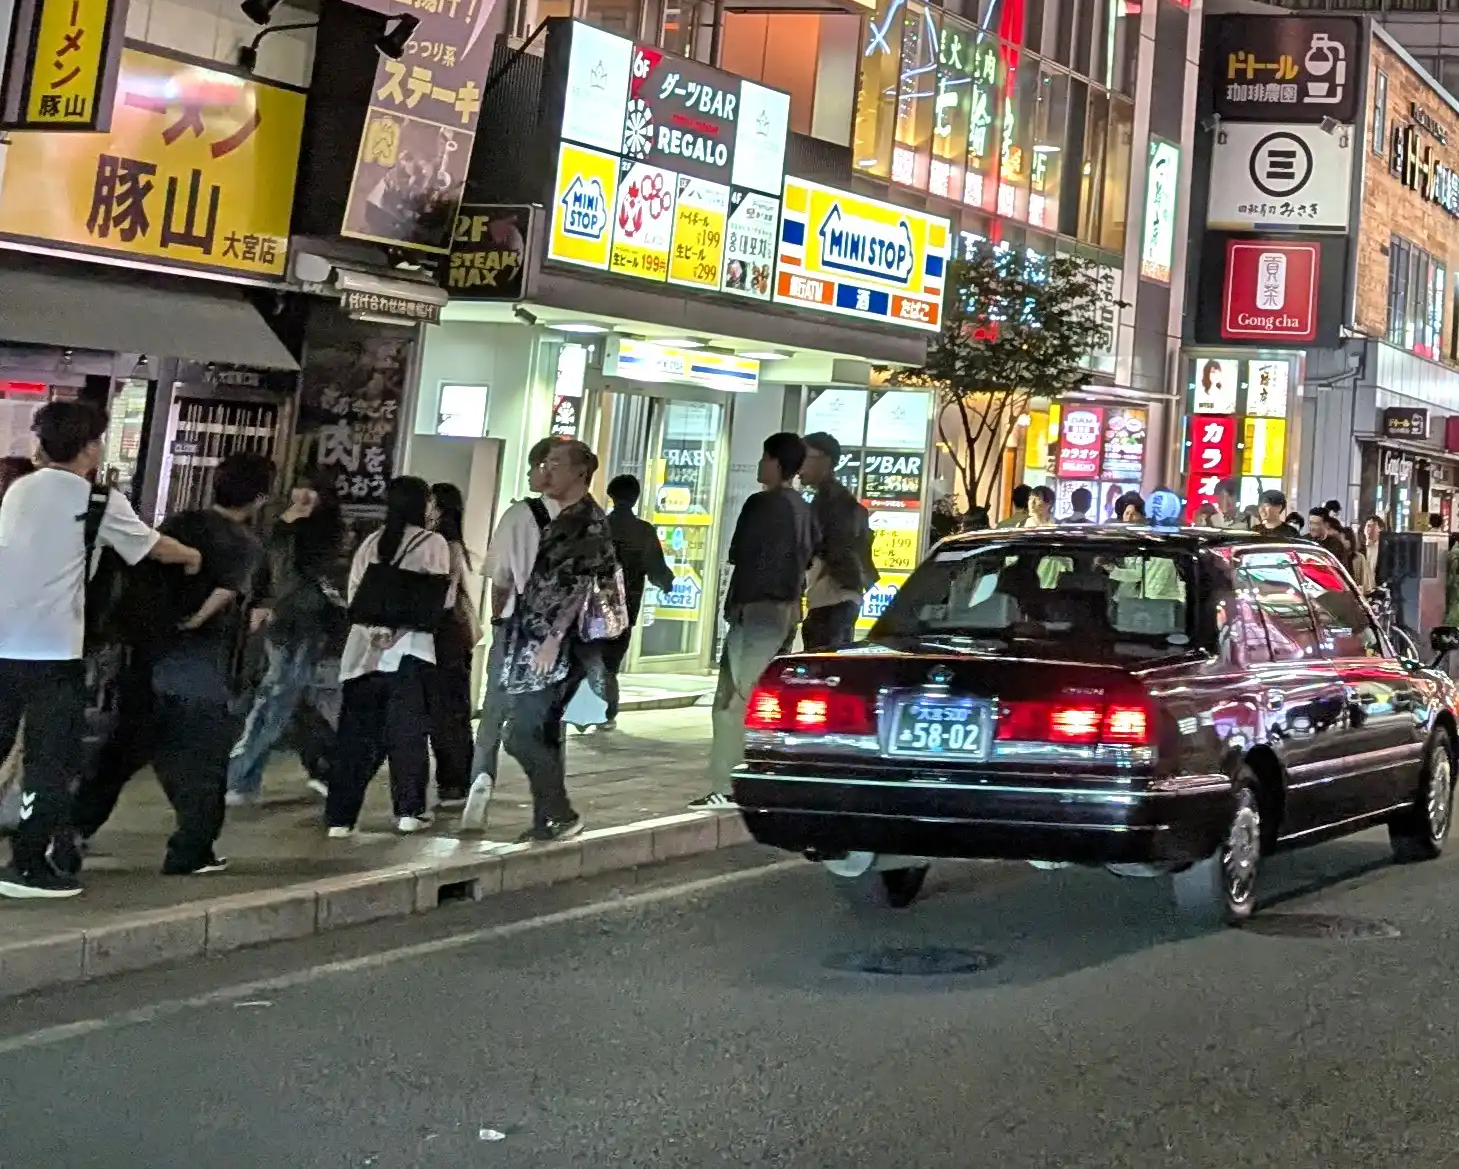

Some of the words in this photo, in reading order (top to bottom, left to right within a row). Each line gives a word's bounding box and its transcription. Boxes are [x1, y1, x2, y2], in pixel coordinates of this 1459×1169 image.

[404, 37, 456, 68] っつり系
[634, 51, 650, 78] 6F
[1227, 51, 1299, 80] ドトール
[376, 61, 481, 123] ステーキ
[659, 72, 736, 121] ダーツBAR
[1227, 83, 1297, 103] 珈琲農園
[37, 94, 86, 119] 豚山
[657, 125, 728, 167] REGALO
[85, 152, 221, 256] 豚山
[573, 191, 599, 212] MINI
[454, 215, 489, 242] 2F
[570, 215, 598, 230] STOP
[222, 231, 277, 265] 大宮店
[450, 250, 522, 271] STEAK
[448, 266, 498, 288] MAX
[1238, 314, 1274, 330] Gong
[1276, 313, 1299, 328] cha
[1197, 422, 1224, 513] カラオ
[868, 604, 887, 616] STO
[870, 592, 895, 606] MIN
